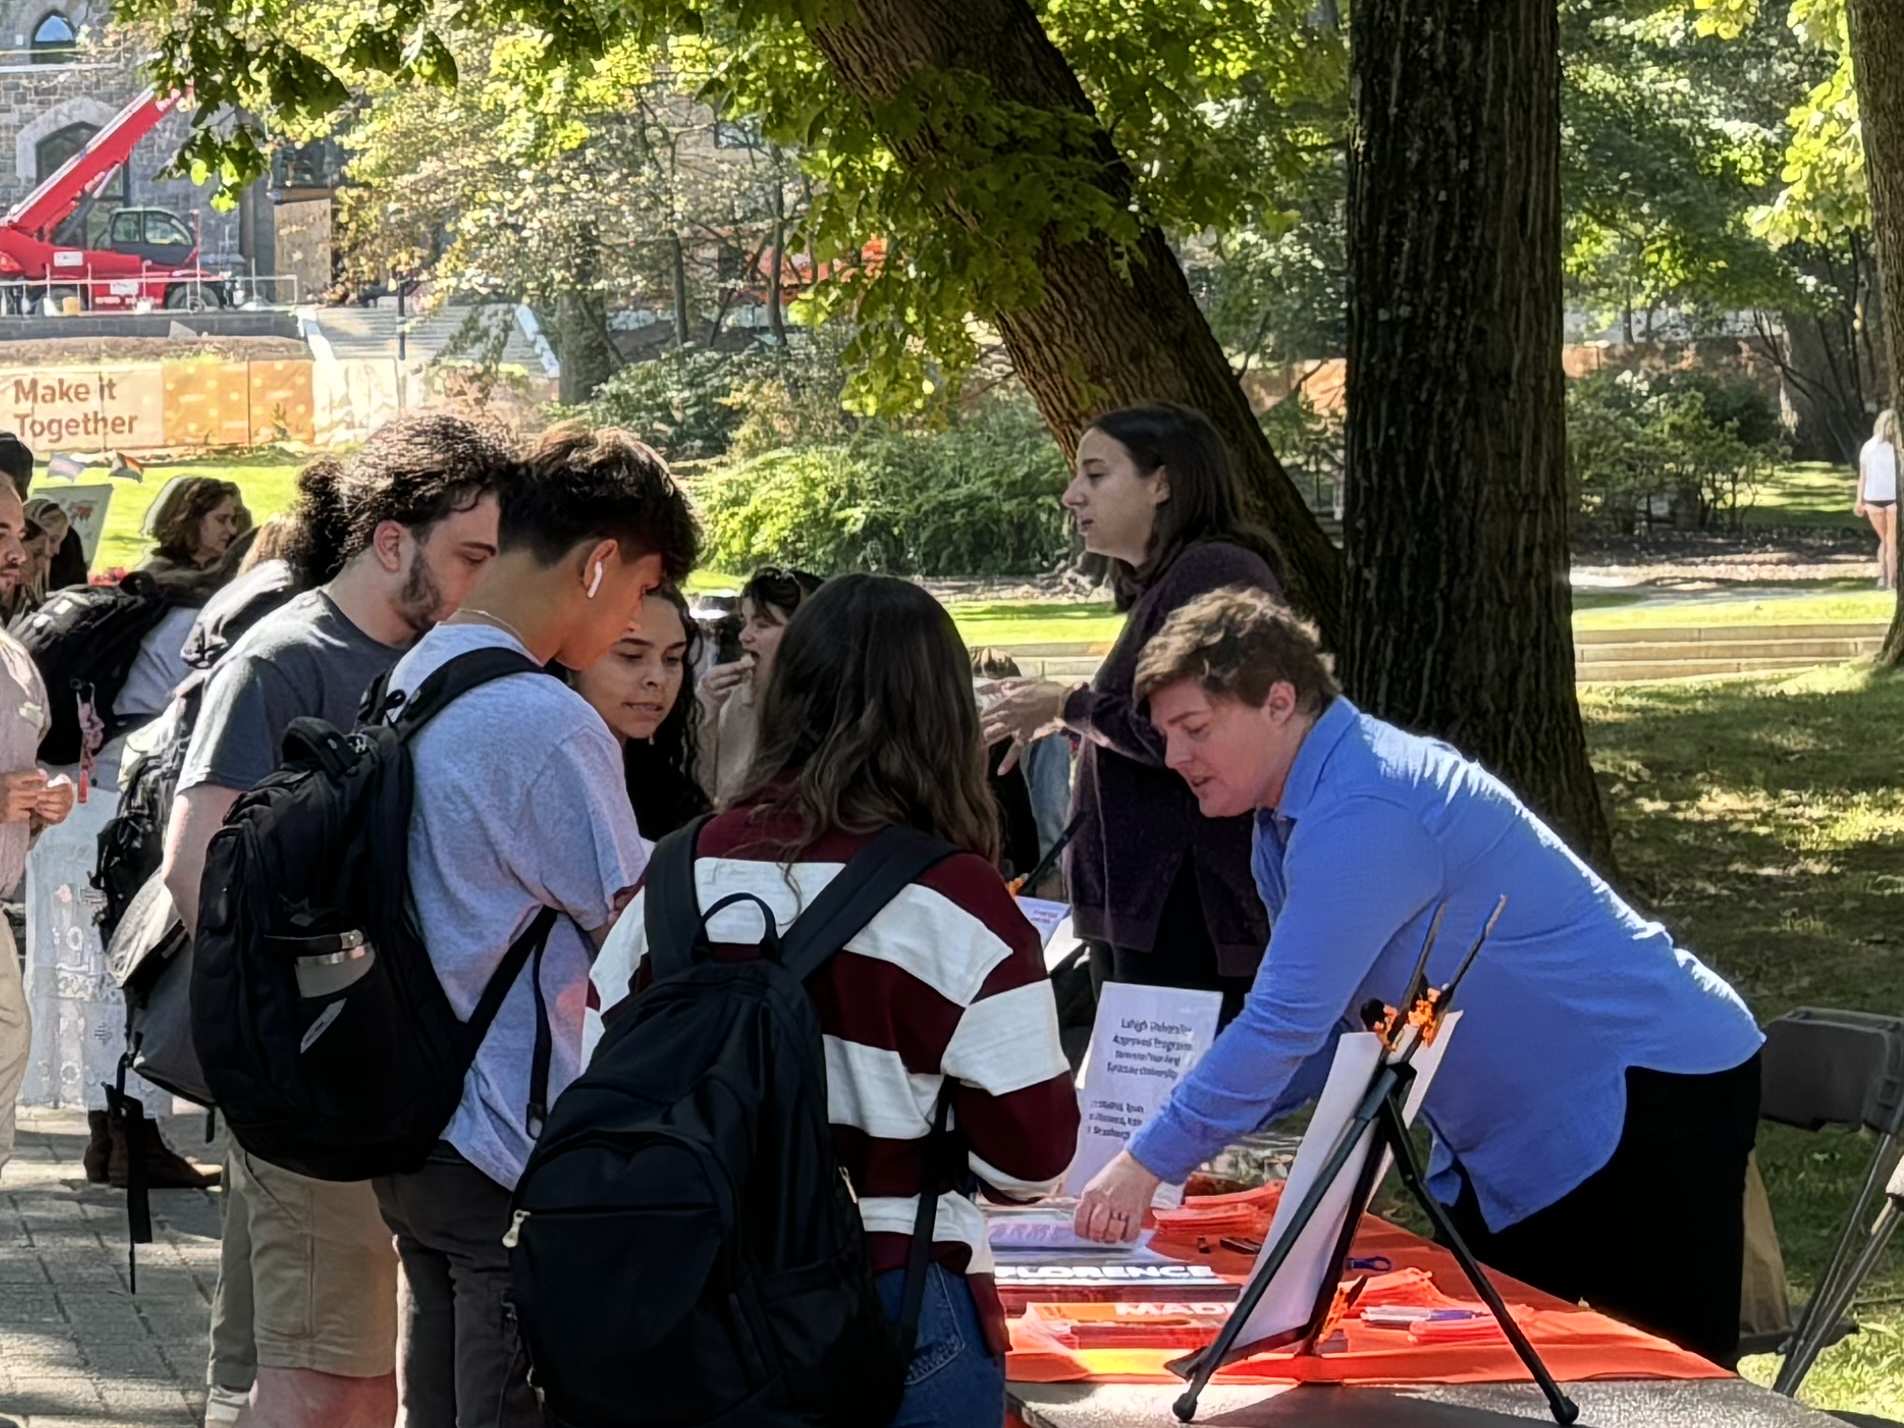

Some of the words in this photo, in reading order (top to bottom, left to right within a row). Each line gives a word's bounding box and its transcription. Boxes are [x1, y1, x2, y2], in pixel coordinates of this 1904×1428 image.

[14, 378, 90, 405] Make
[99, 376, 116, 402] it
[14, 410, 139, 443] Together
[995, 1265, 1216, 1278] FLORENCE
[1114, 1302, 1235, 1316] MAD
